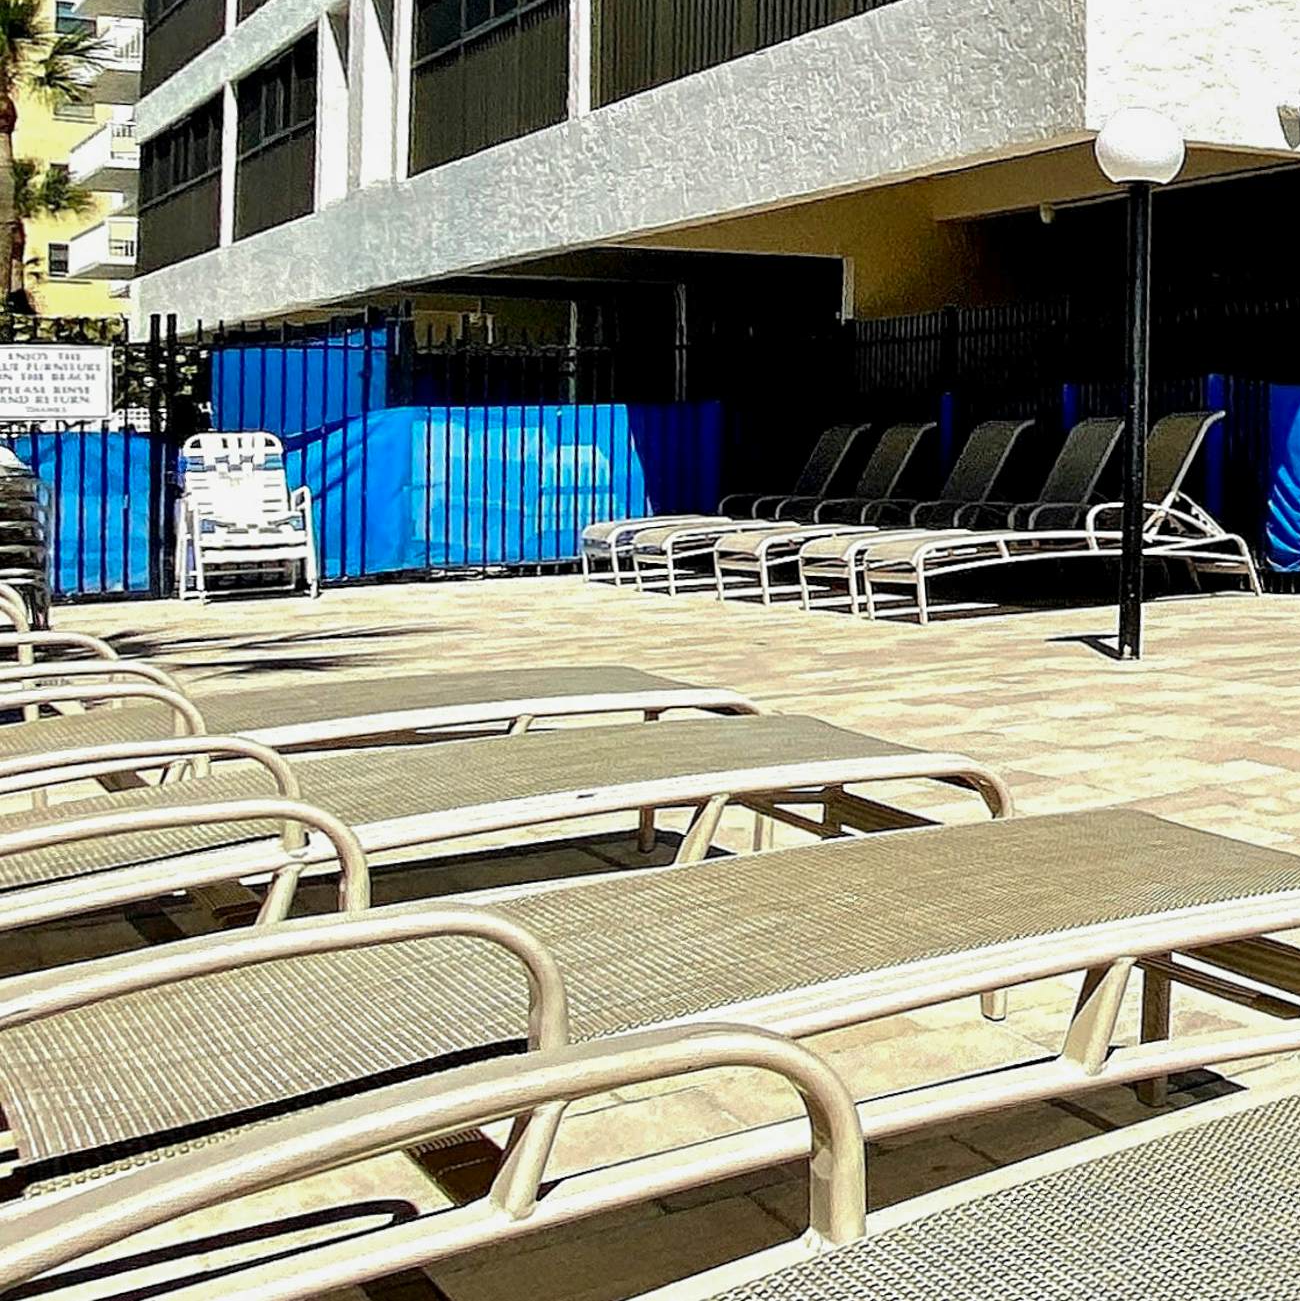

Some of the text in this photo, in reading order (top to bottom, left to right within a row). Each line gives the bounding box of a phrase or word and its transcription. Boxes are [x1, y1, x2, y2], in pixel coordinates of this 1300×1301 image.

[7, 352, 81, 361] ENJOY THE
[0, 362, 102, 372] LUE FURNITURE
[20, 373, 44, 381] THE
[51, 373, 96, 381] BEACH
[0, 385, 90, 394] PLEASE RINSE
[34, 395, 91, 404] RETURN
